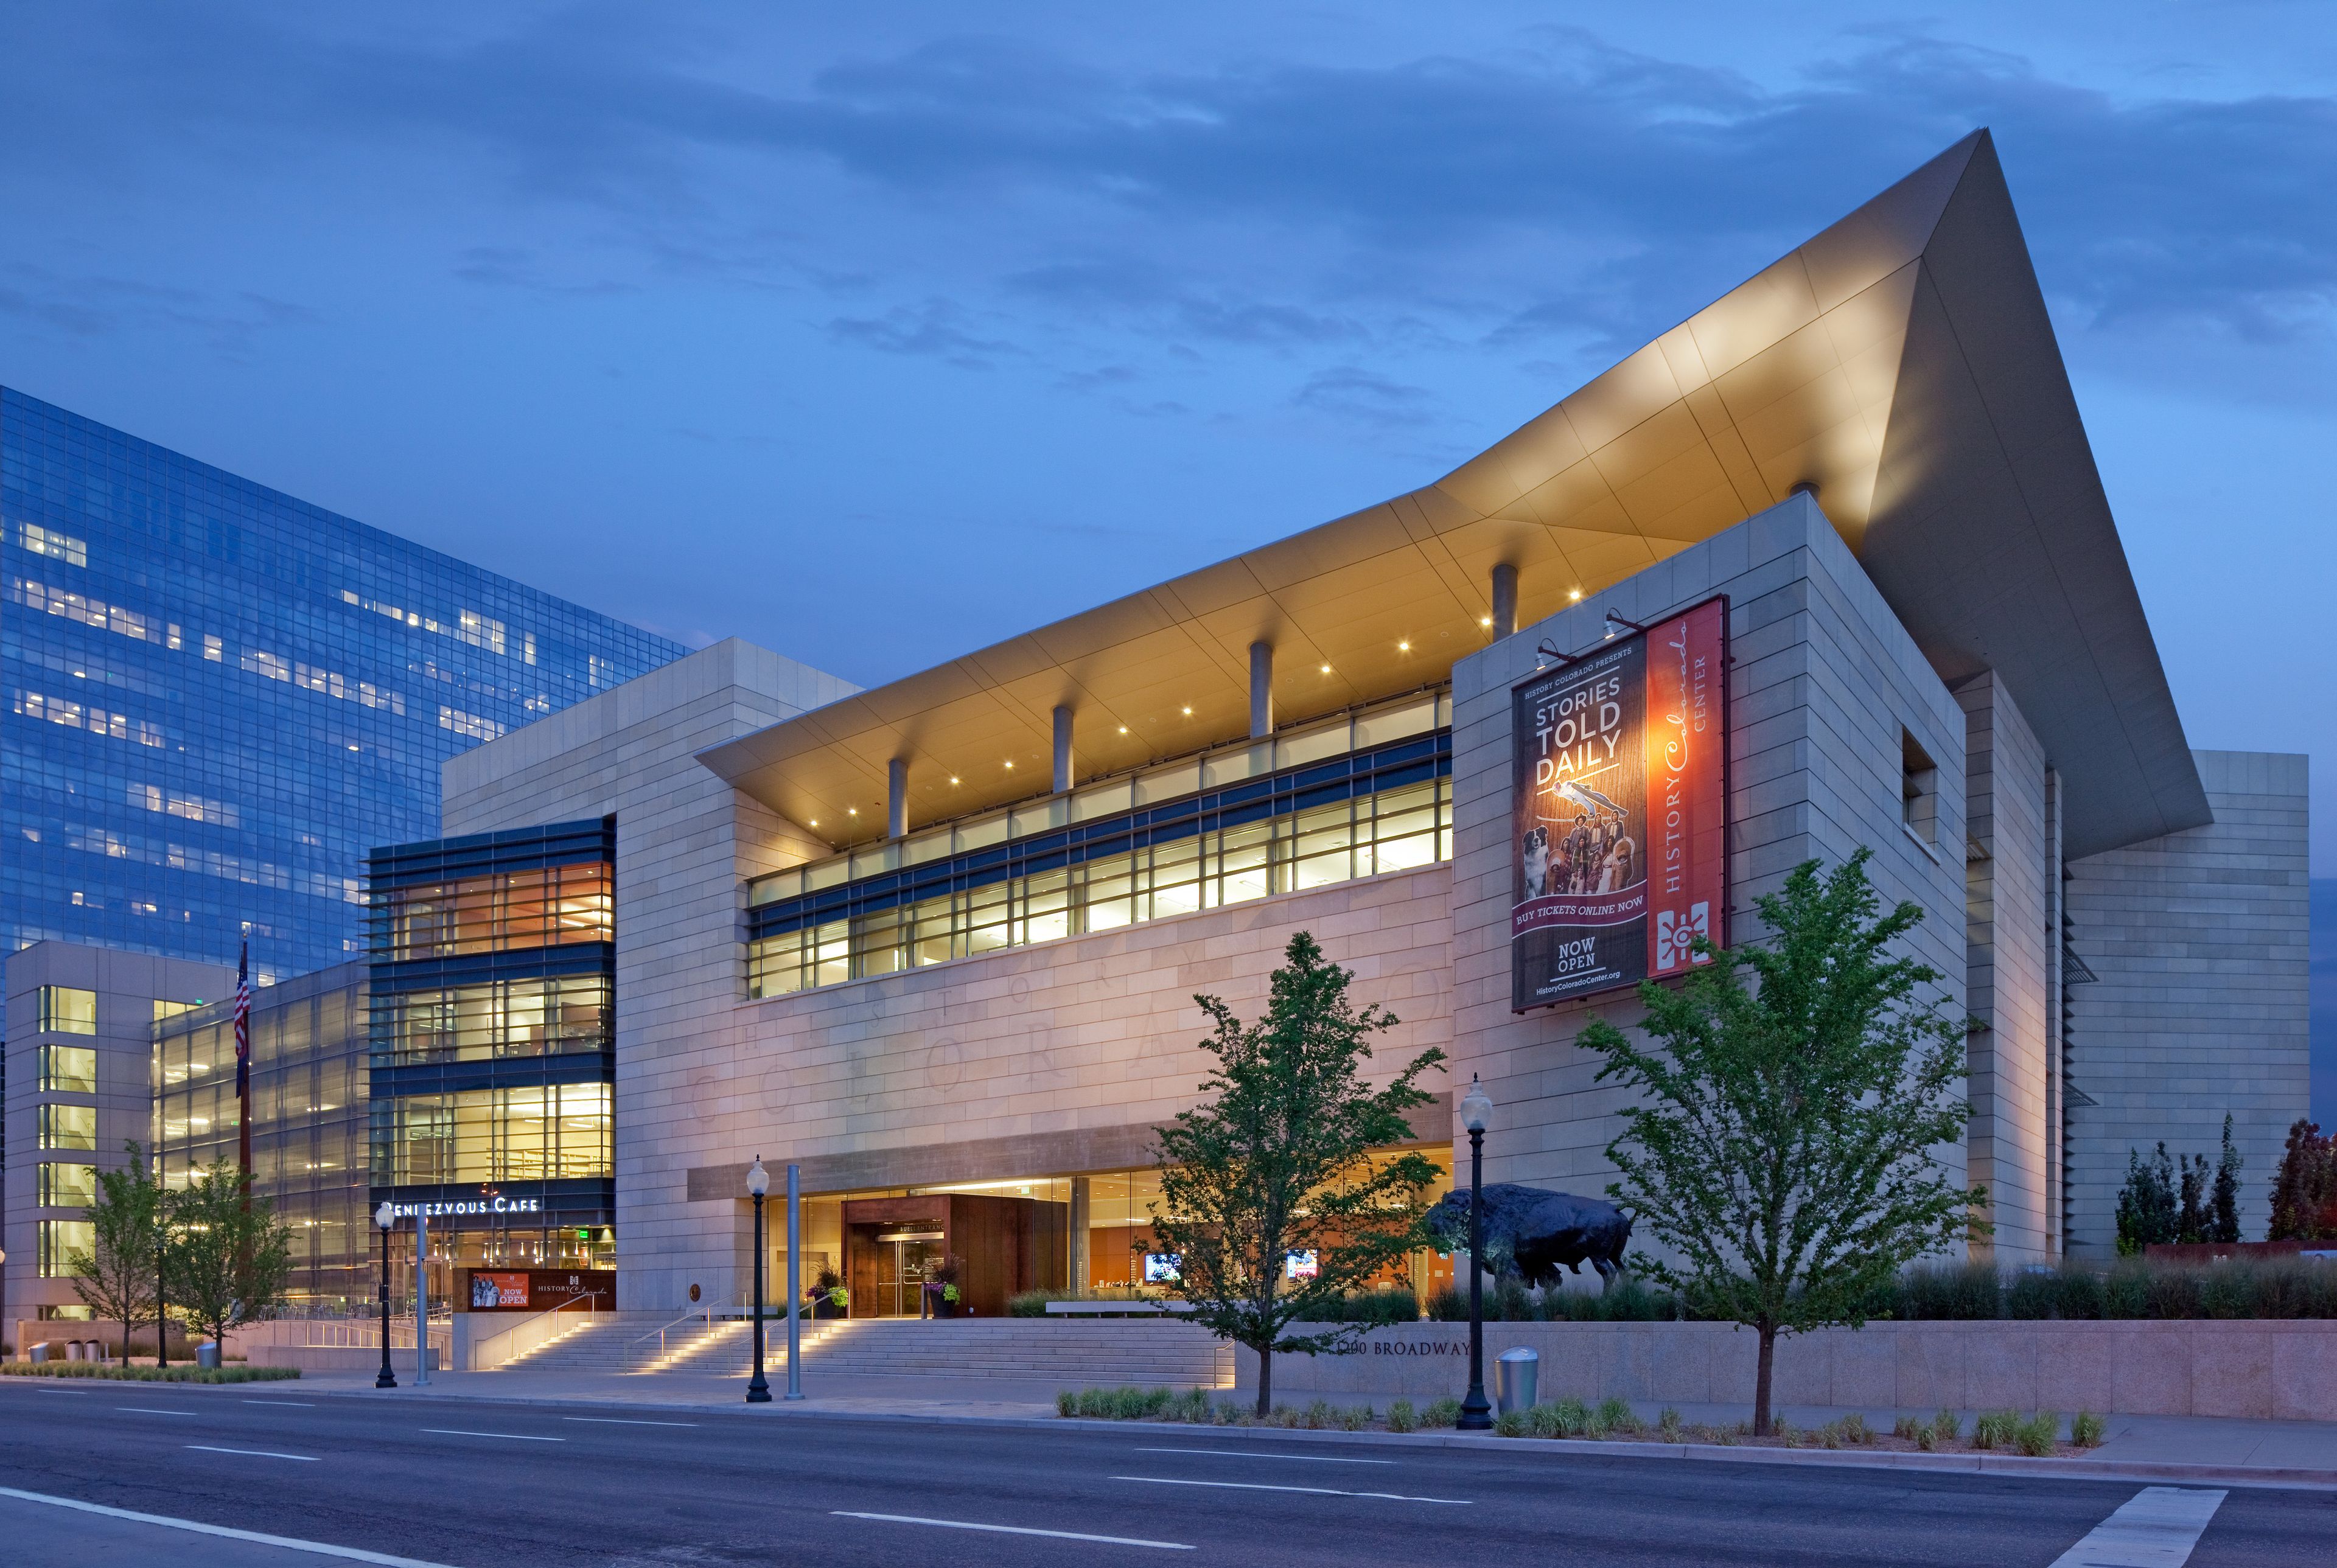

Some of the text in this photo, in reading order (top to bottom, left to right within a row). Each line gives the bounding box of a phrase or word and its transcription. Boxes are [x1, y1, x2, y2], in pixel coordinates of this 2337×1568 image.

[1525, 647, 1632, 700] HISTORY COLORADO PRESENTS
[1694, 655, 1706, 733] CENTER
[1536, 677, 1620, 727] STORIES
[1536, 702, 1620, 756] TOLD
[1536, 729, 1622, 786] DAILY
[1665, 621, 1688, 894] HISTORY Colorado
[1516, 895, 1643, 925] BUY TICKETS ONLINE NOW
[1558, 953, 1595, 973] OPEN
[1559, 936, 1596, 959] NOW
[1536, 971, 1621, 995] HistoryColoradoCenter.org
[692, 963, 1441, 1124] COLORAO
[570, 1285, 607, 1295] Colorado
[1337, 1342, 1473, 1356] 1200 BROADWAY
